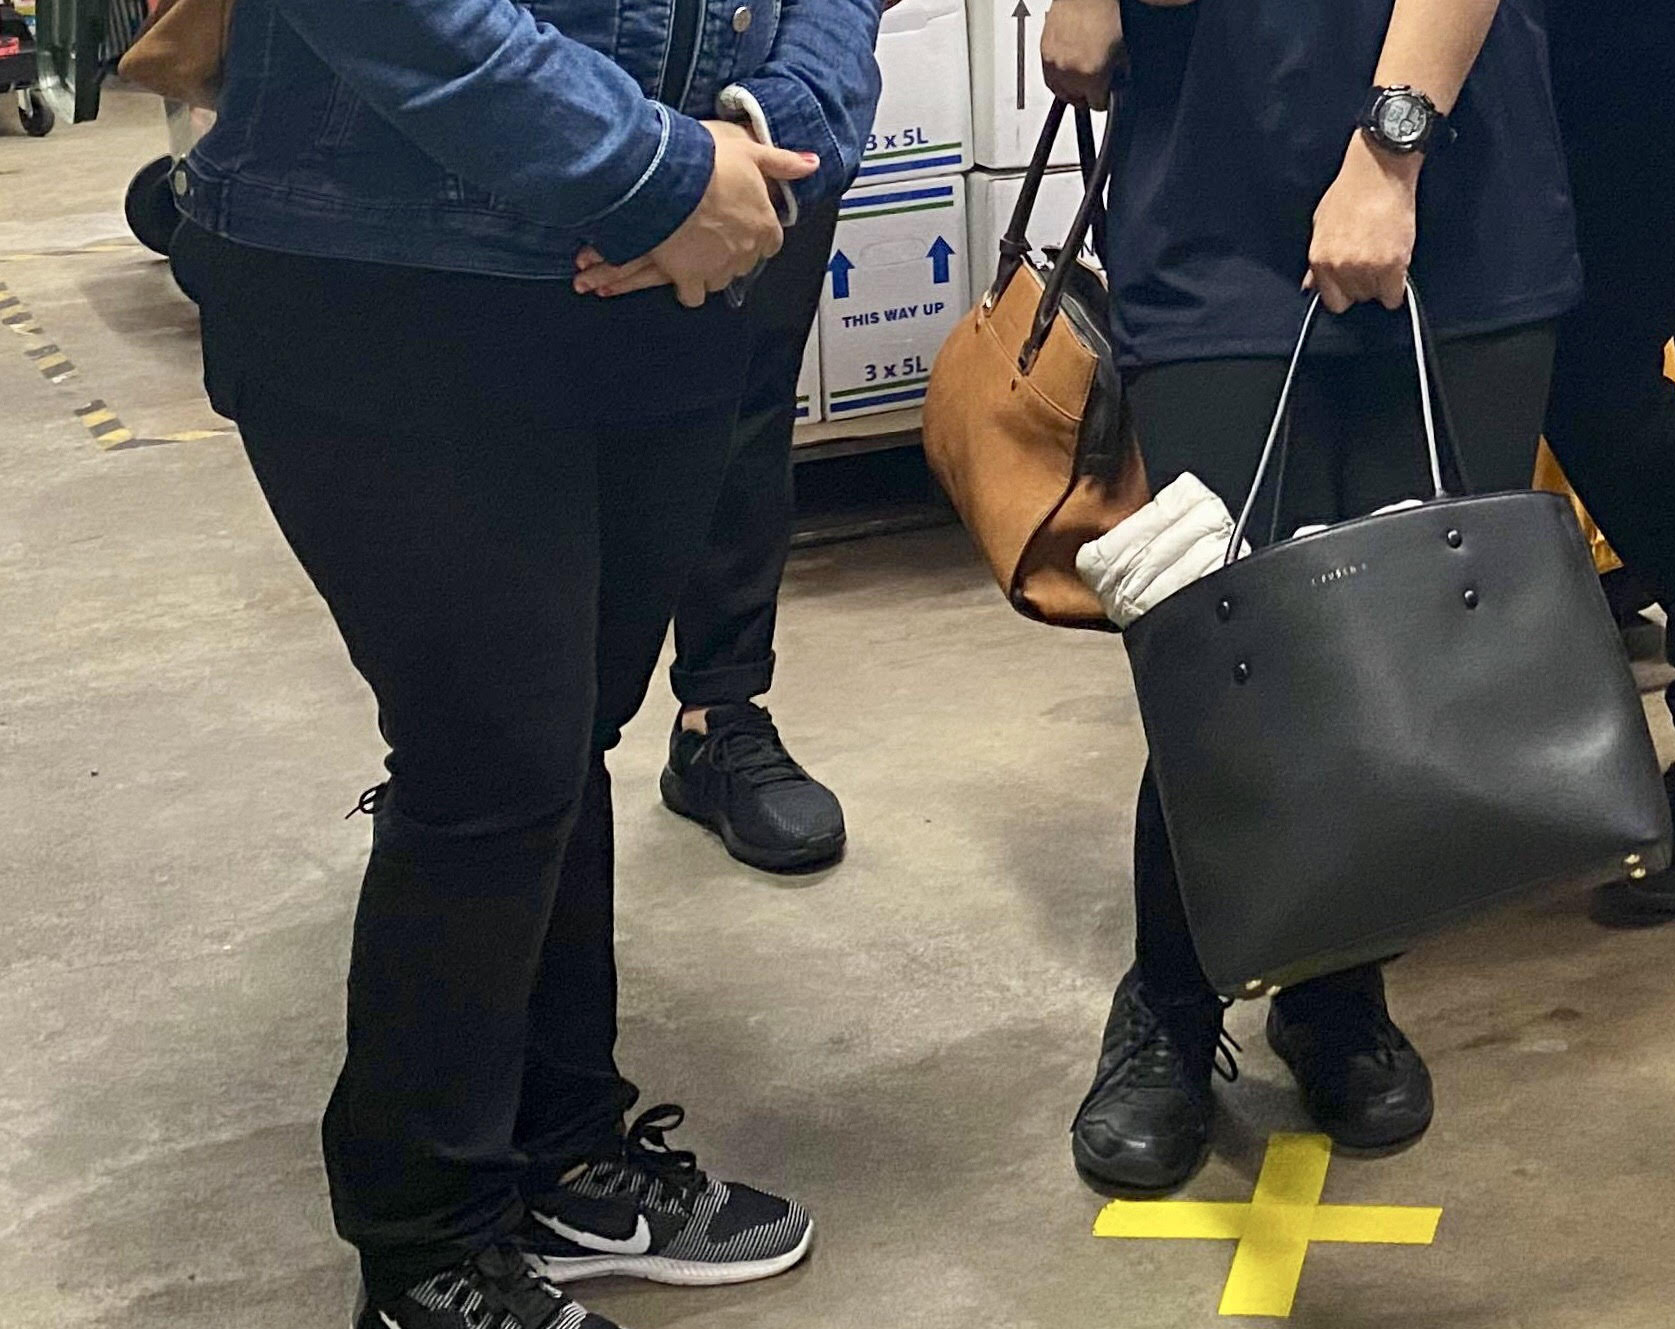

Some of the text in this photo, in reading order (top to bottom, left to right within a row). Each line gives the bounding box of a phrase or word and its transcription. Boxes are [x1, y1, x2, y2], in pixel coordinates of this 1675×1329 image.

[865, 127, 929, 151] 3 x 5L
[842, 302, 945, 328] THIS WAY UP
[864, 355, 928, 382] 3 x 5L
